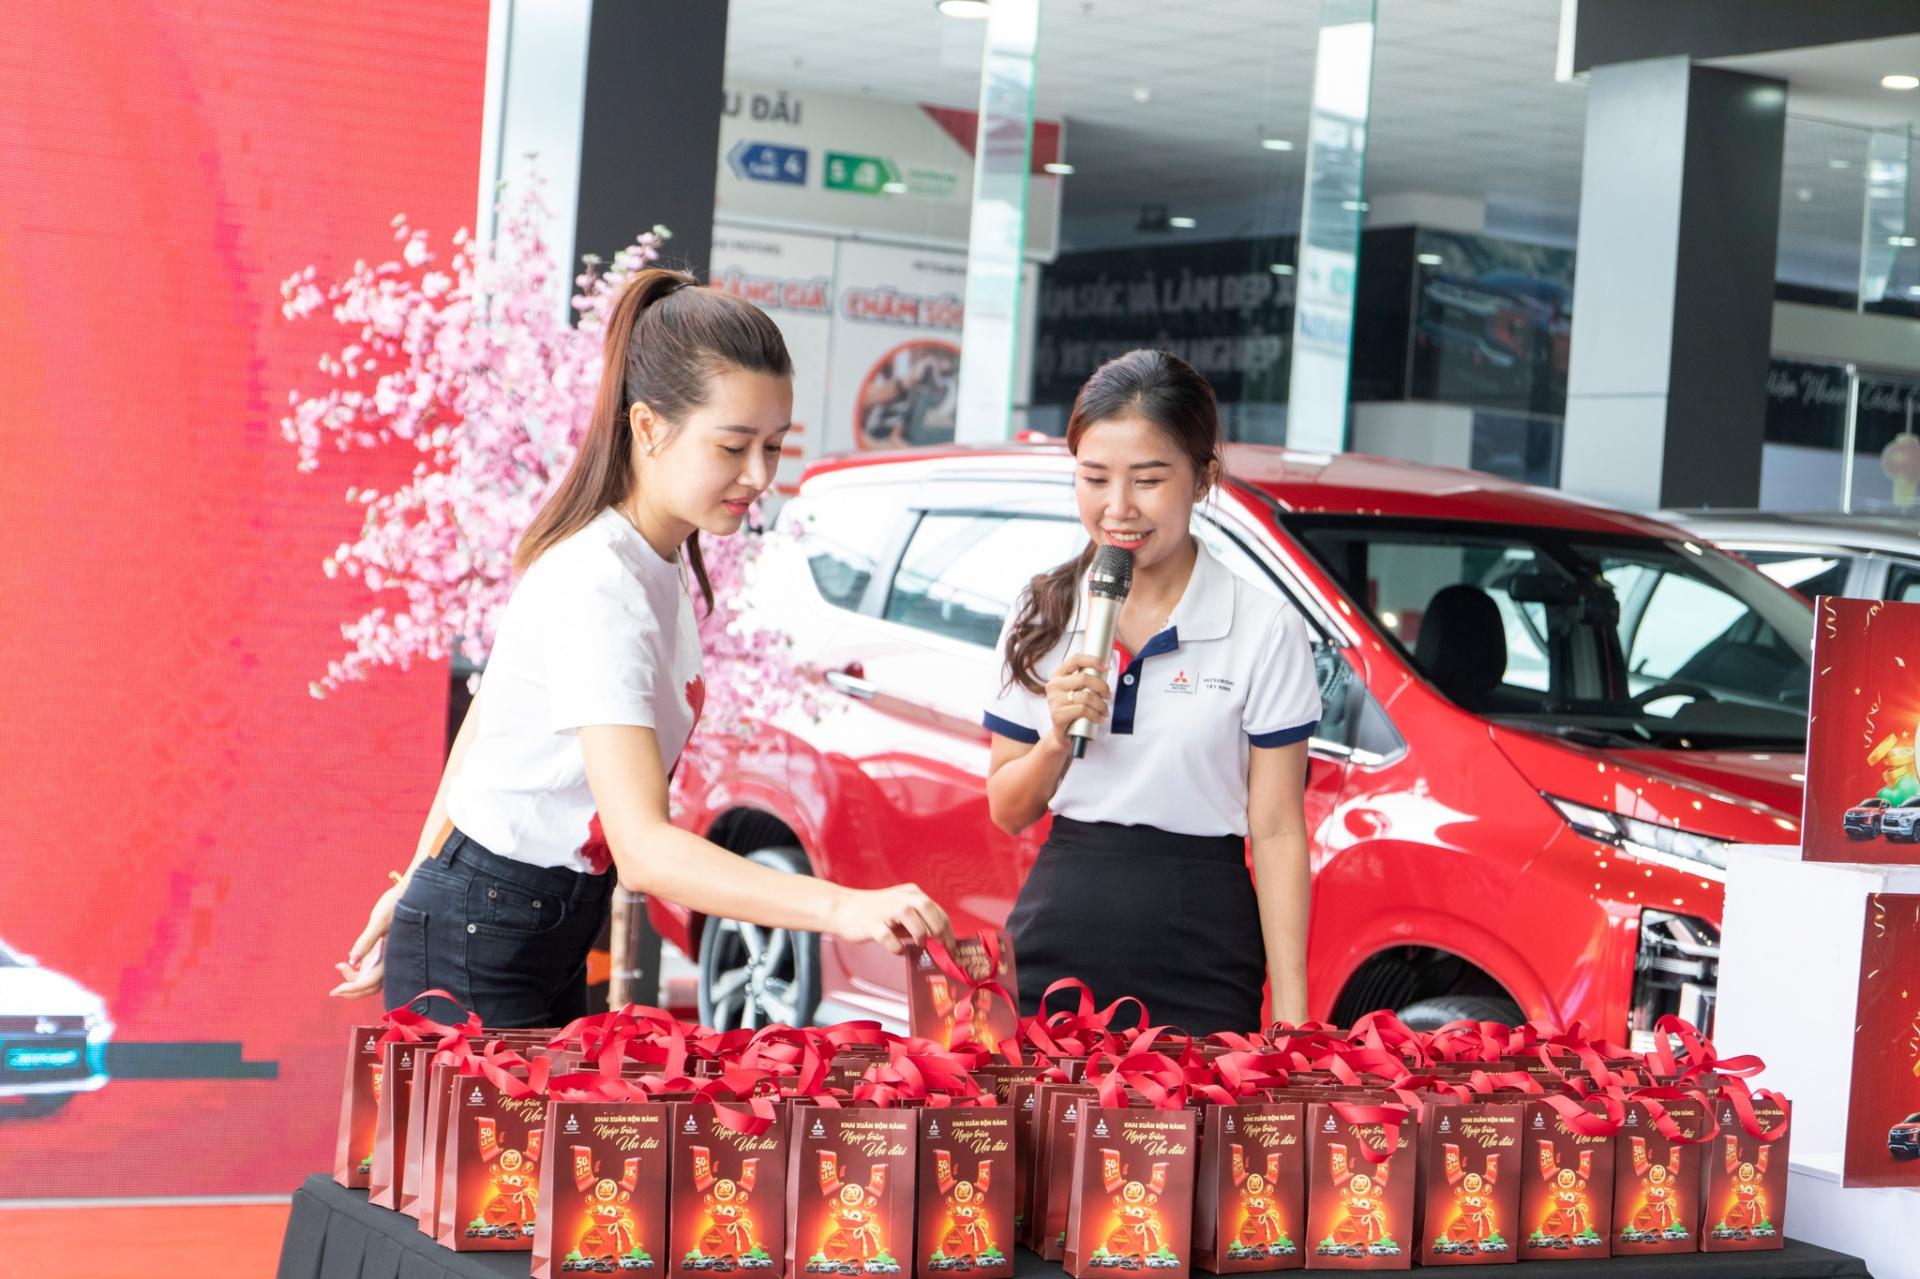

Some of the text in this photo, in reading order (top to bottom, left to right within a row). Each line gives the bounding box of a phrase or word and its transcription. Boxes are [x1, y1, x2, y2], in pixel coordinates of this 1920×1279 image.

[721, 91, 802, 125] U ĐÃI
[1162, 268, 1217, 313] LÀM
